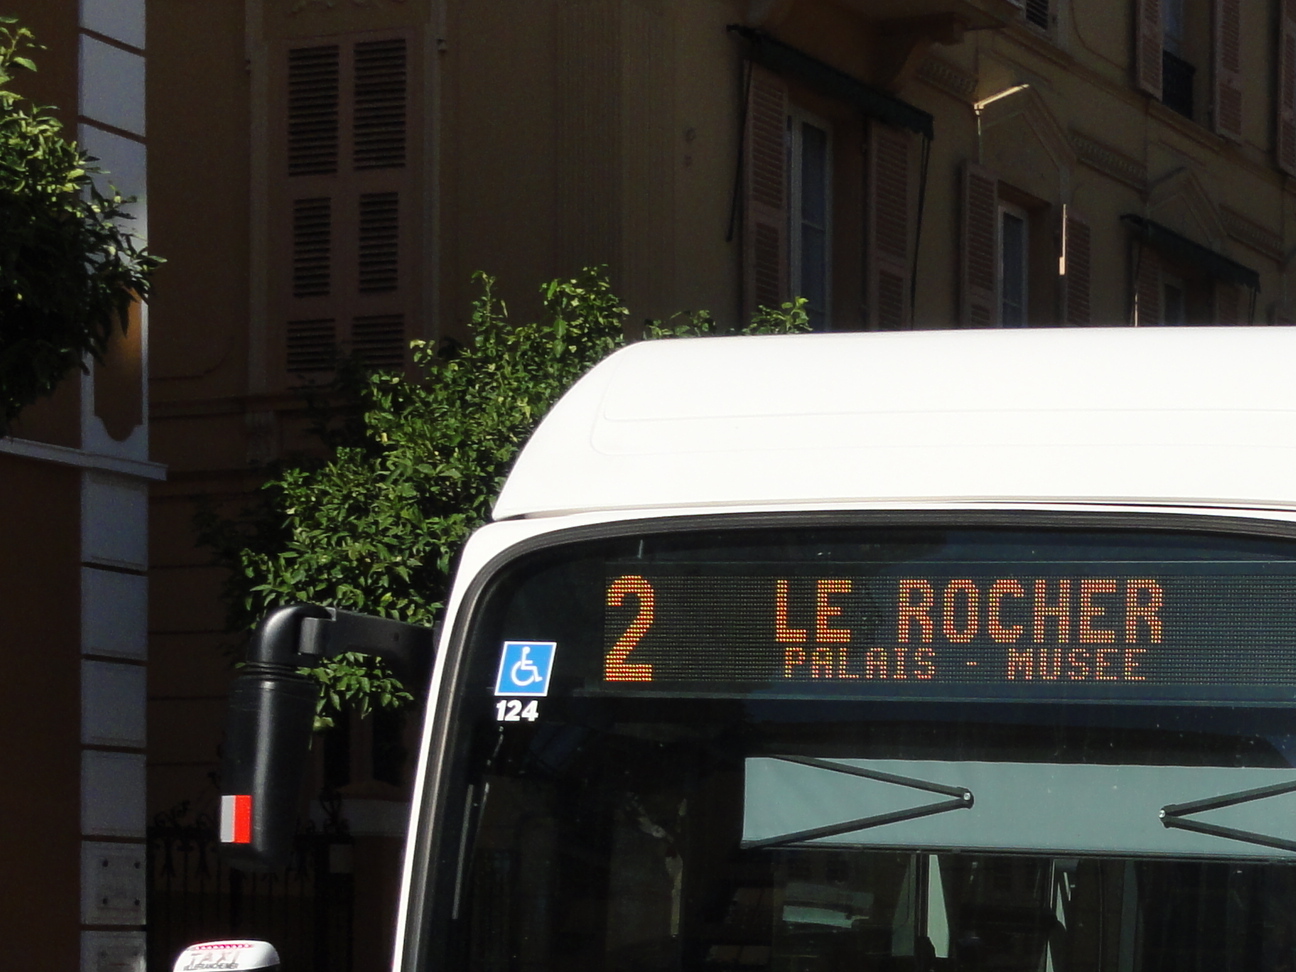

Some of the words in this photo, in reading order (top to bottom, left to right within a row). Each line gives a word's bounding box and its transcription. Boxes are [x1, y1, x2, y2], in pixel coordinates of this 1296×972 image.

[606, 575, 654, 681] 2
[776, 579, 852, 643] LE
[899, 579, 1164, 643] ROCHER
[784, 647, 937, 679] PALAIS
[1007, 648, 1148, 681] MUSEE
[496, 700, 539, 721] 124
[190, 951, 240, 967] TAXI
